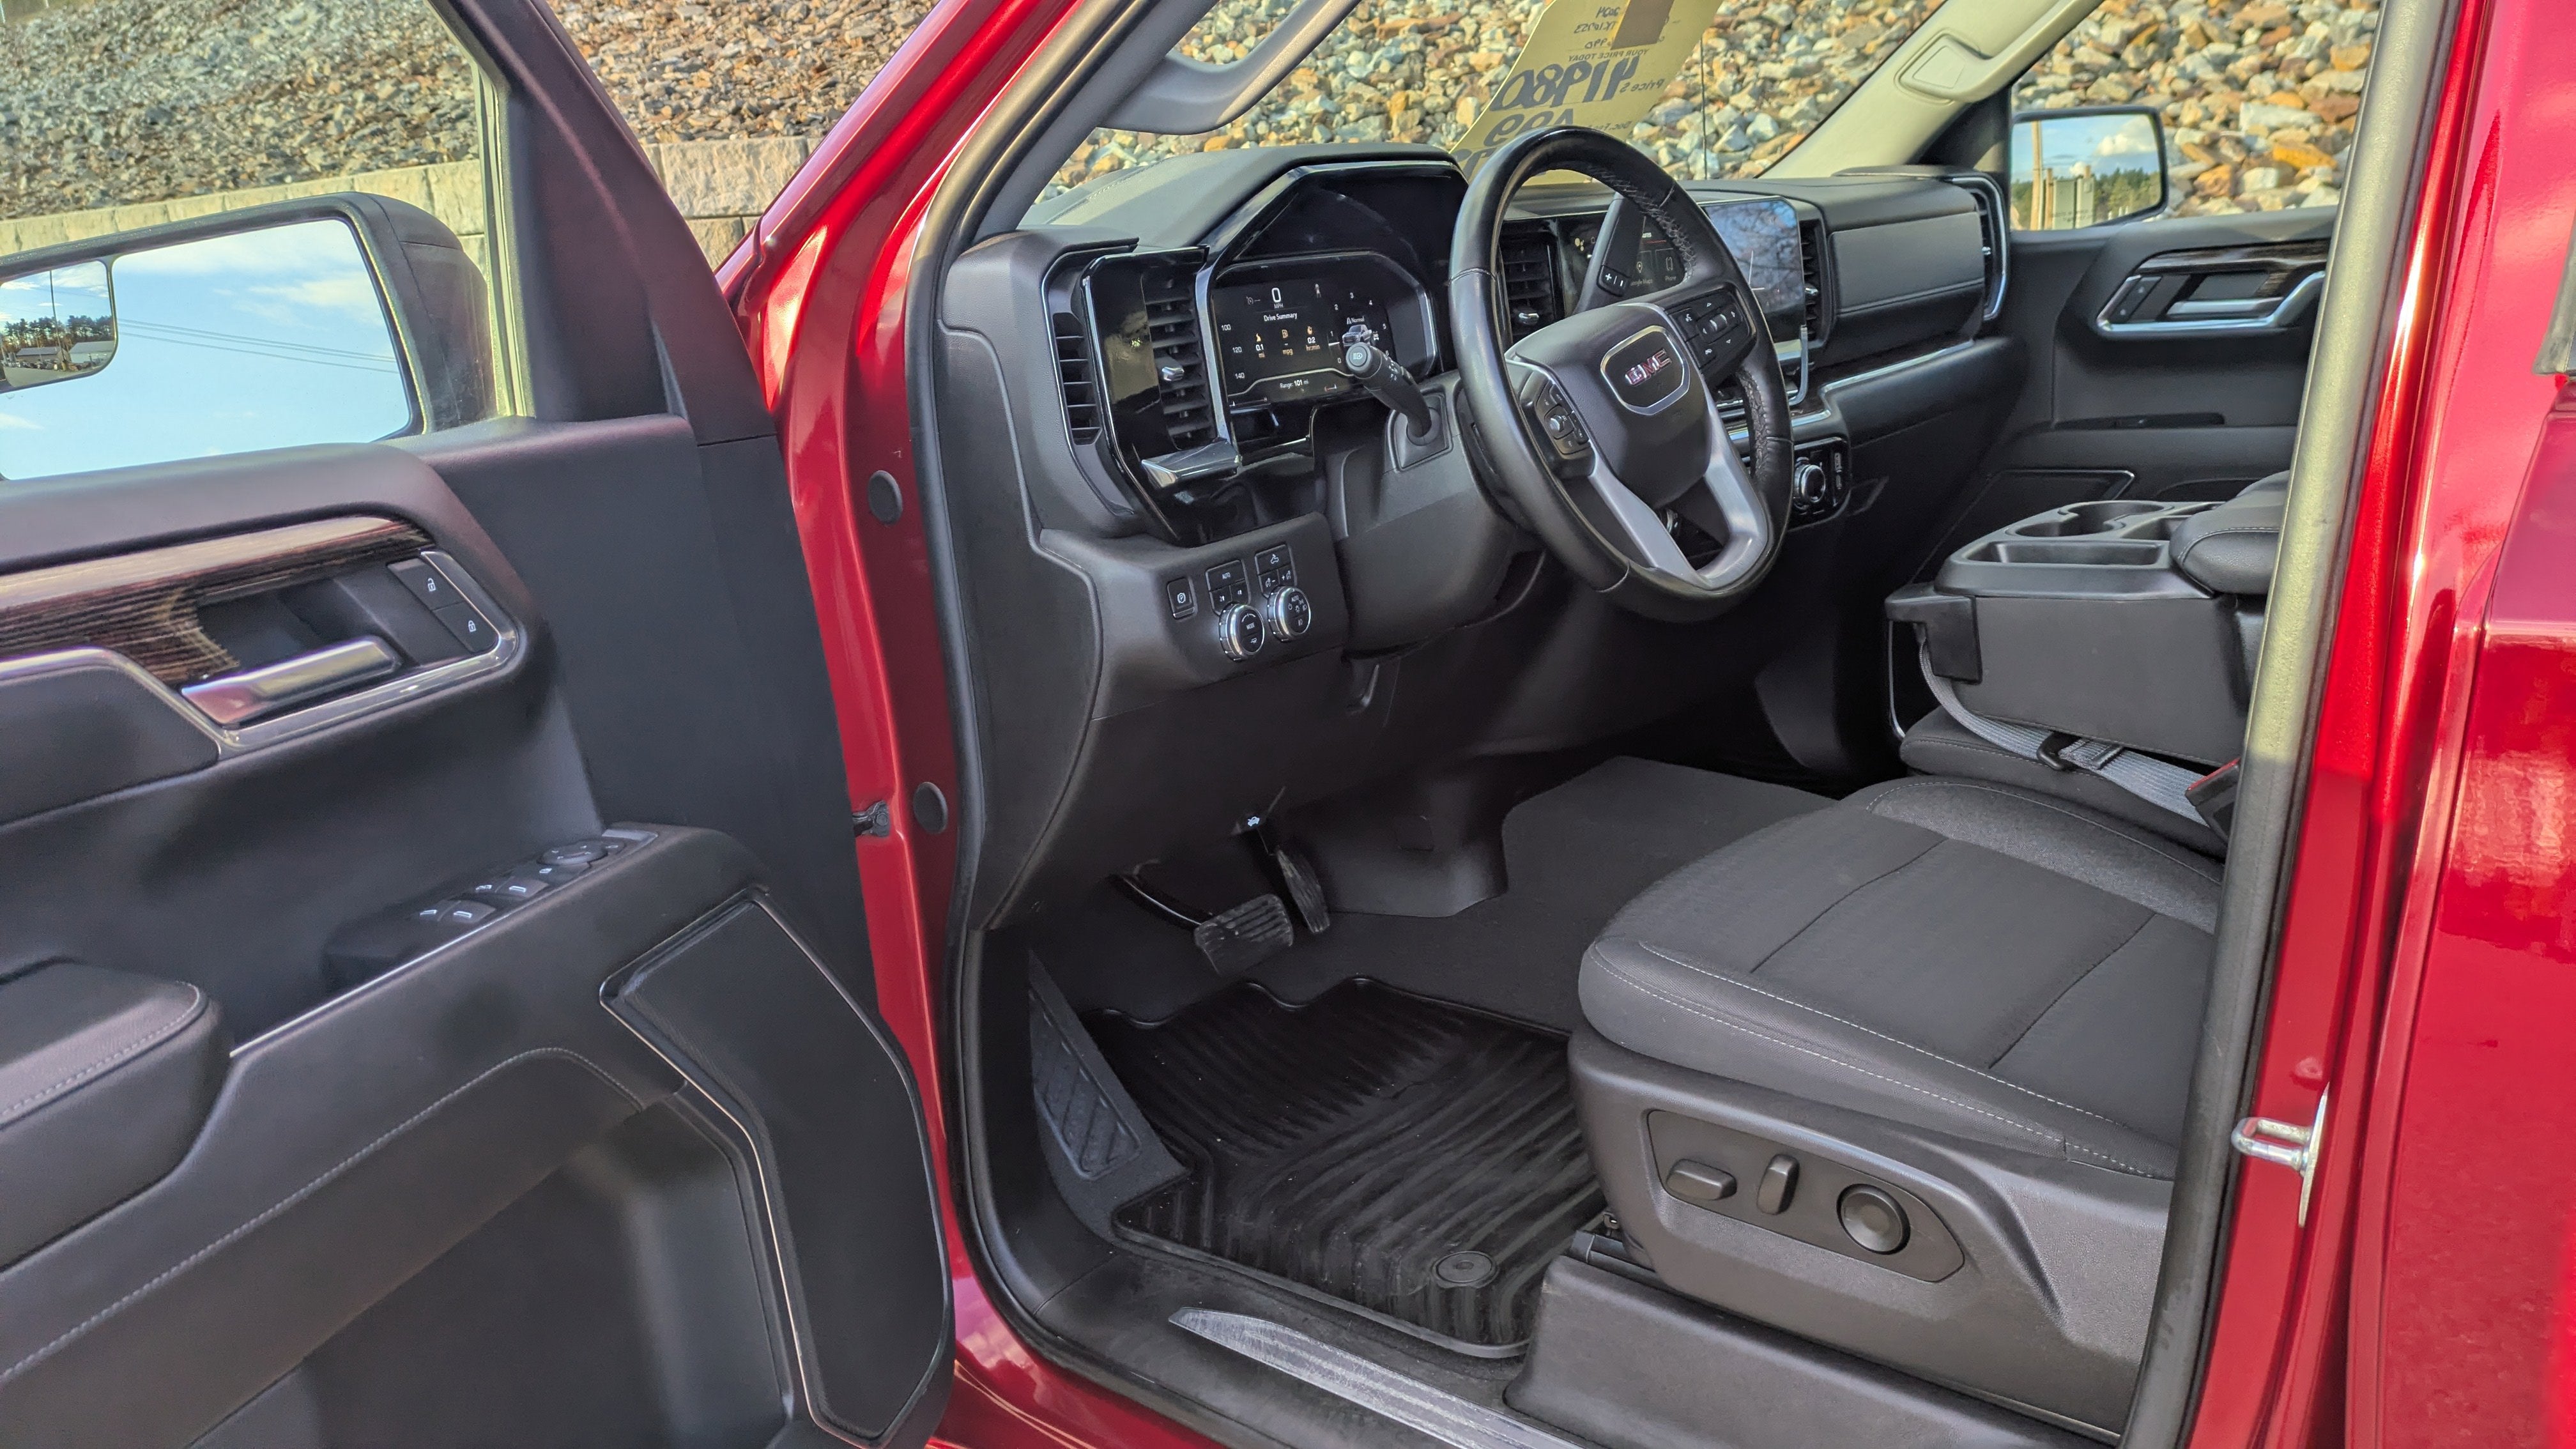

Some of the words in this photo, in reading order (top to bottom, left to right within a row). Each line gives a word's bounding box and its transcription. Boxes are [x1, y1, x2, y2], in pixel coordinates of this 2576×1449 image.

[1271, 288, 1282, 303] 0
[1263, 314, 1276, 322] Drive
[1276, 312, 1298, 321] Summary
[1625, 349, 1673, 387] GMC
[1280, 381, 1293, 390] Range:
